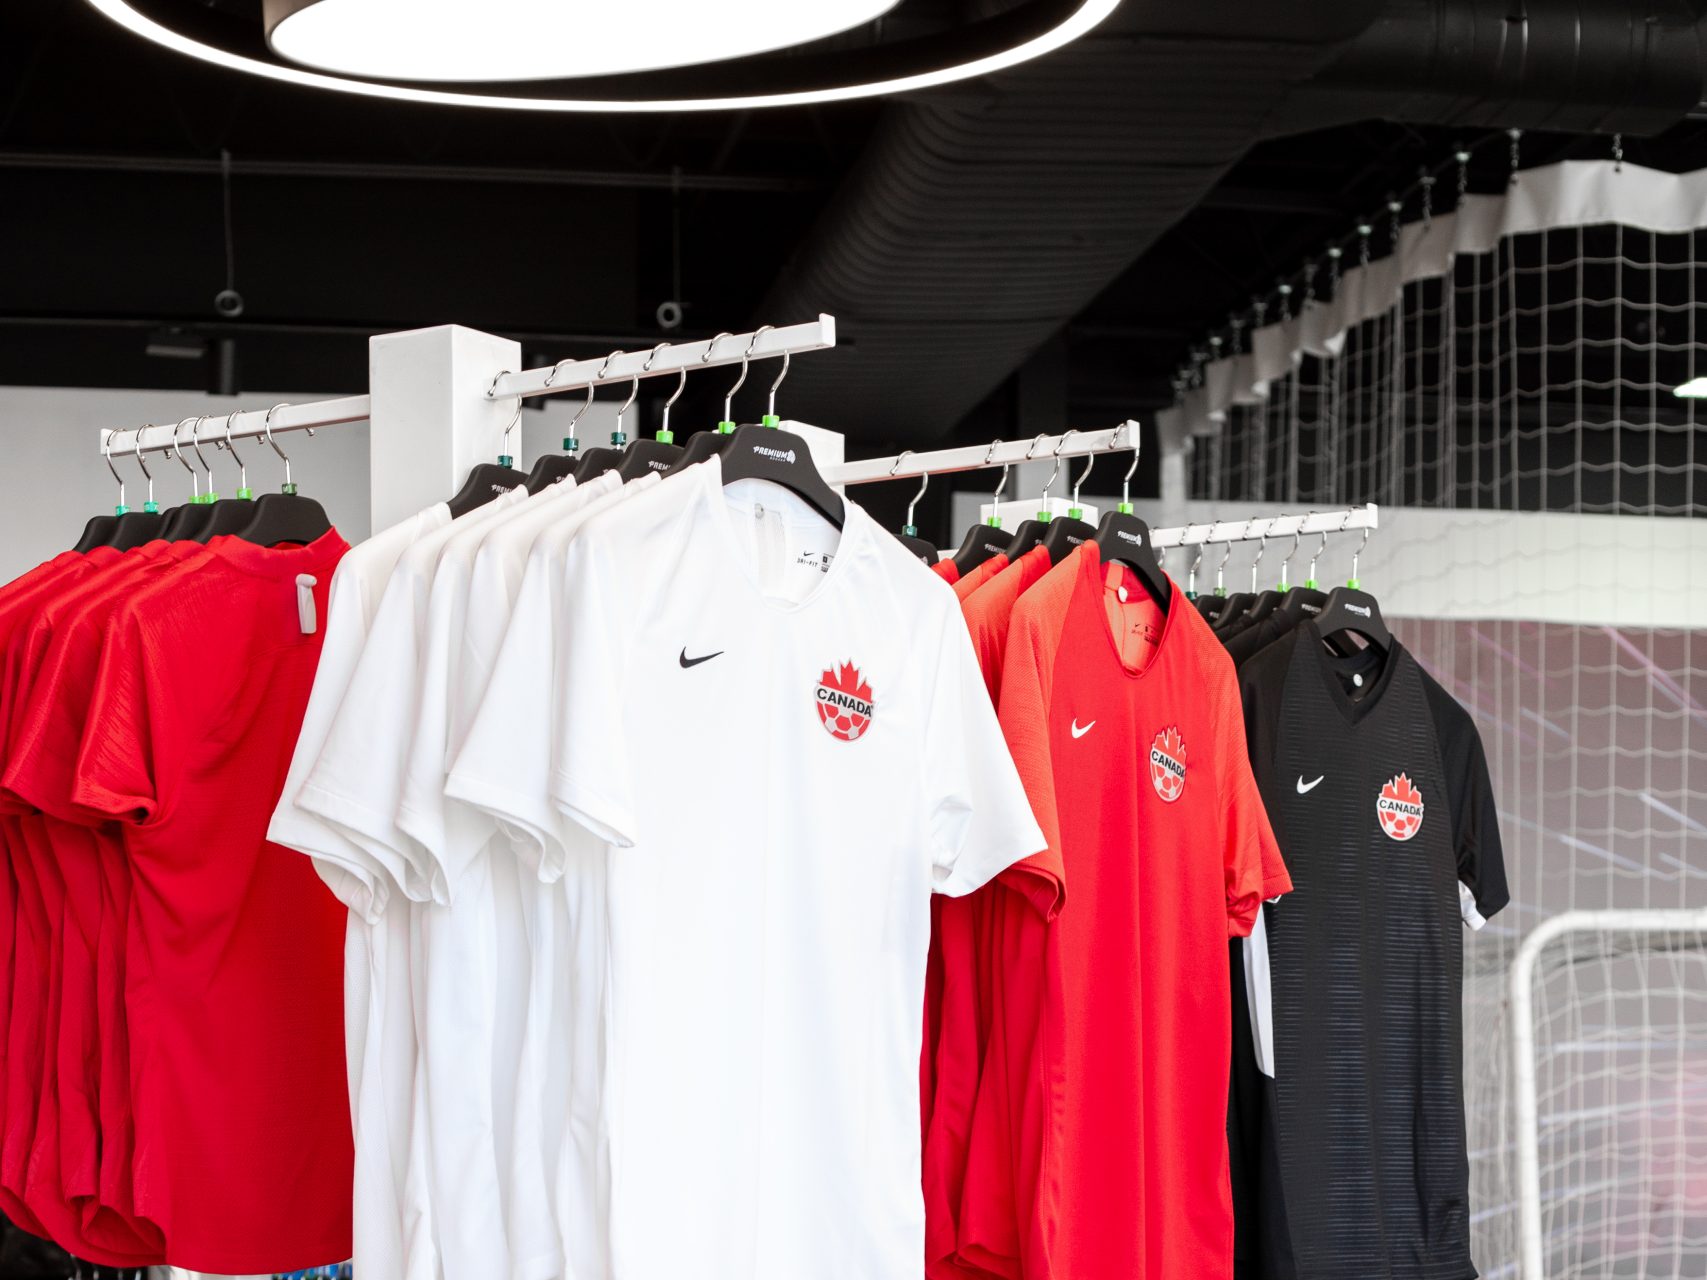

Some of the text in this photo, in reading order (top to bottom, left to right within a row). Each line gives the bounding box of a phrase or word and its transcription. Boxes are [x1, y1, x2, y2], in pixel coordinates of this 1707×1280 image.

[753, 446, 788, 458] PREMIUM
[648, 461, 671, 471] PREM
[491, 484, 513, 494] PREM
[817, 688, 872, 717] CANADA
[1152, 751, 1185, 777] CANADA
[1379, 800, 1421, 816] CANADA
